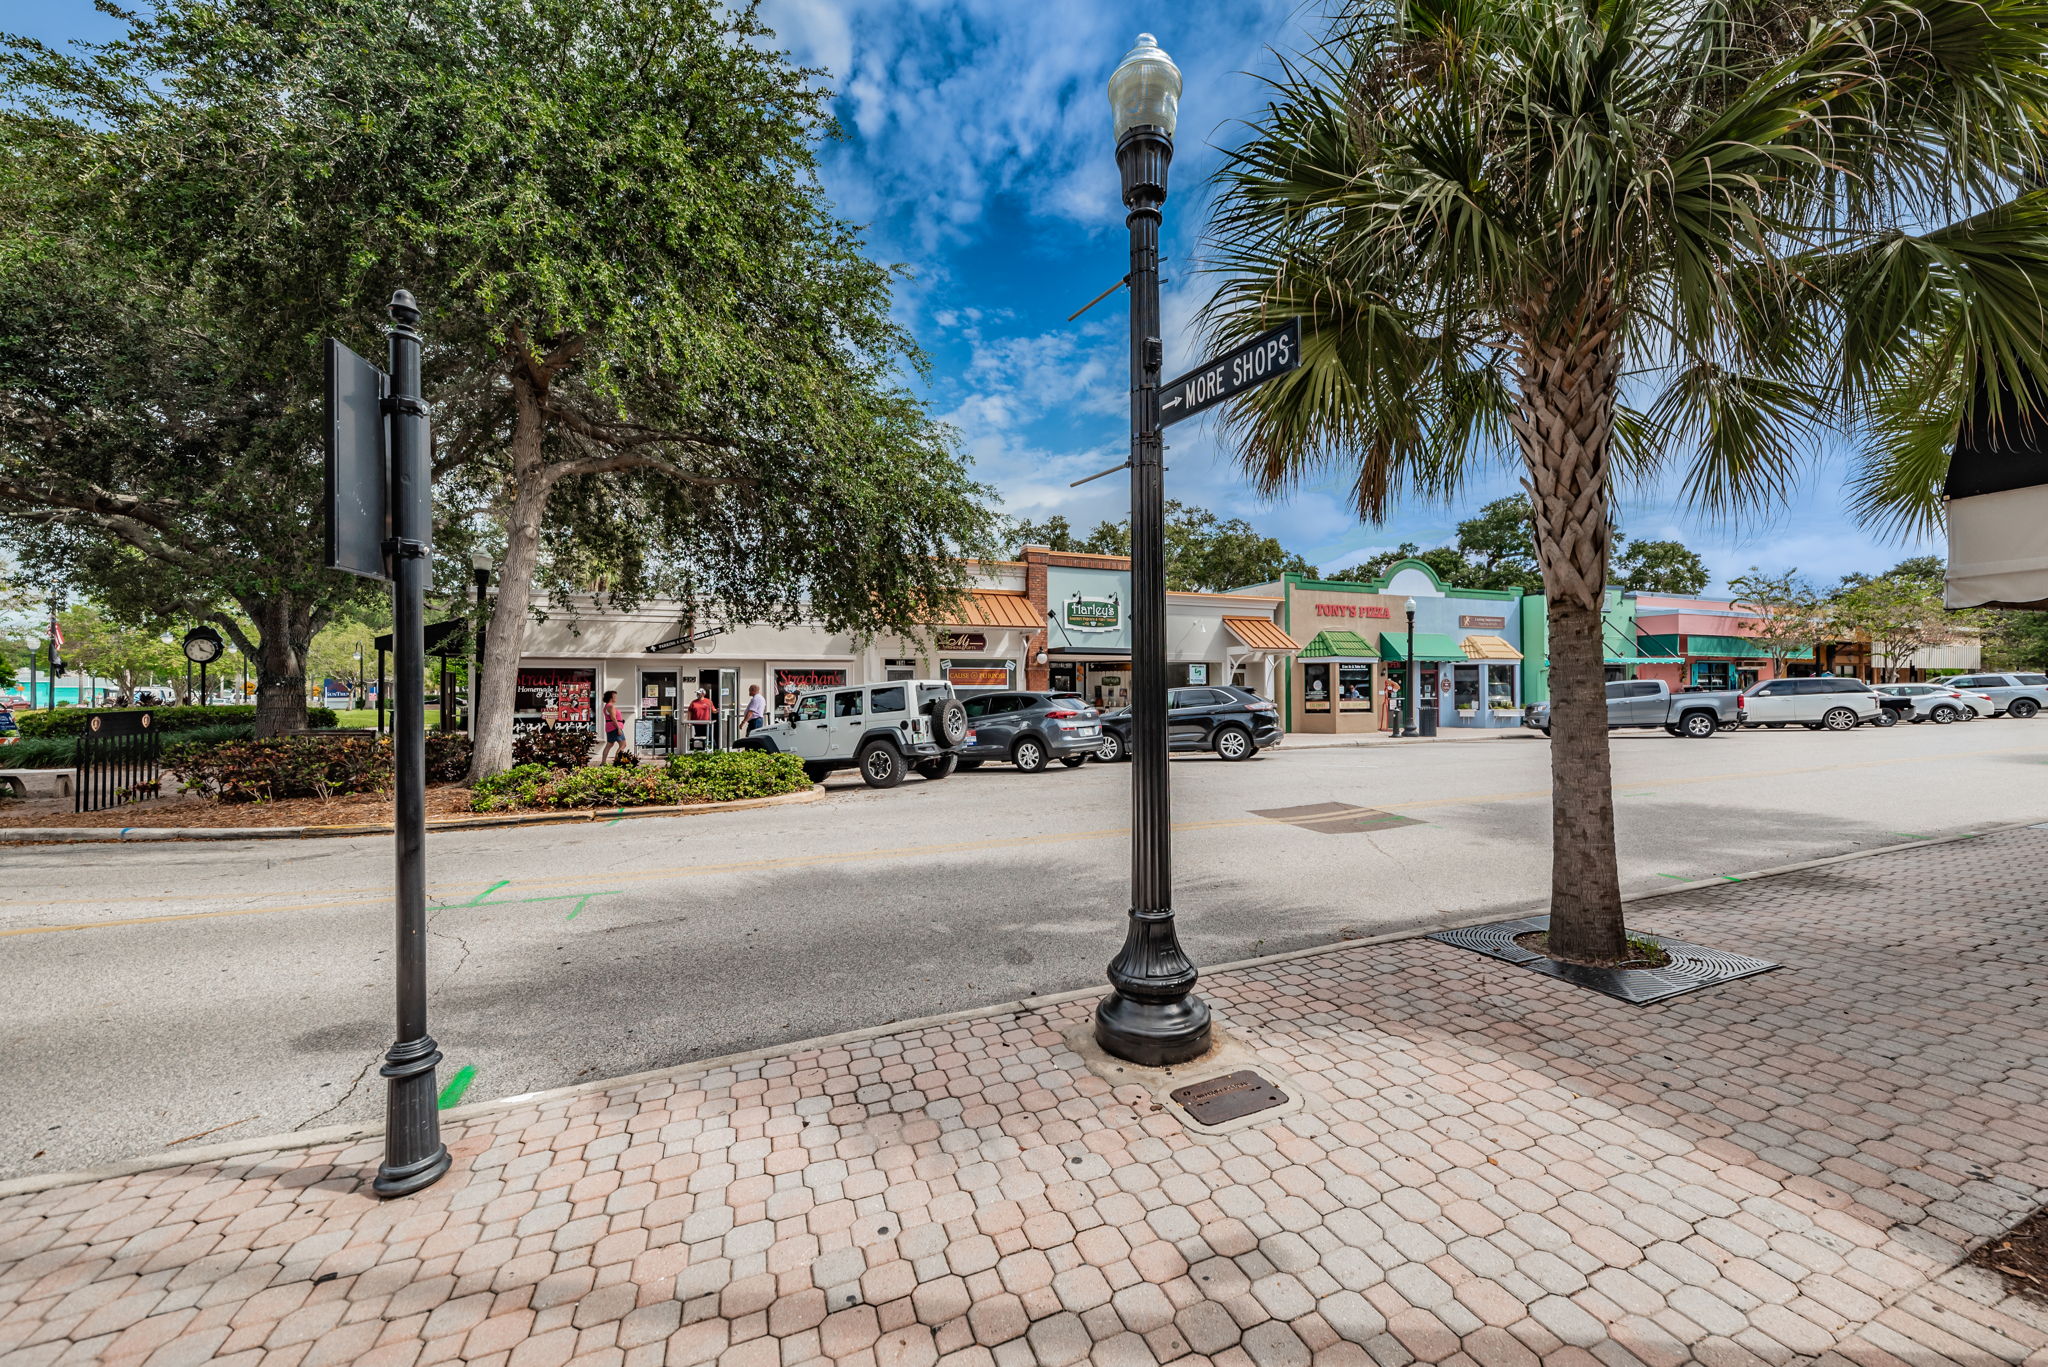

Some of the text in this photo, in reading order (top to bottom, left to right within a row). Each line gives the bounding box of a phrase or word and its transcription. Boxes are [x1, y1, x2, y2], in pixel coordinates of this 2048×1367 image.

[1185, 334, 1290, 409] MORE SHOPS
[1071, 603, 1115, 618] Harley's
[1315, 604, 1393, 619] TONY'S PIZZA
[778, 669, 841, 687] Strachan's
